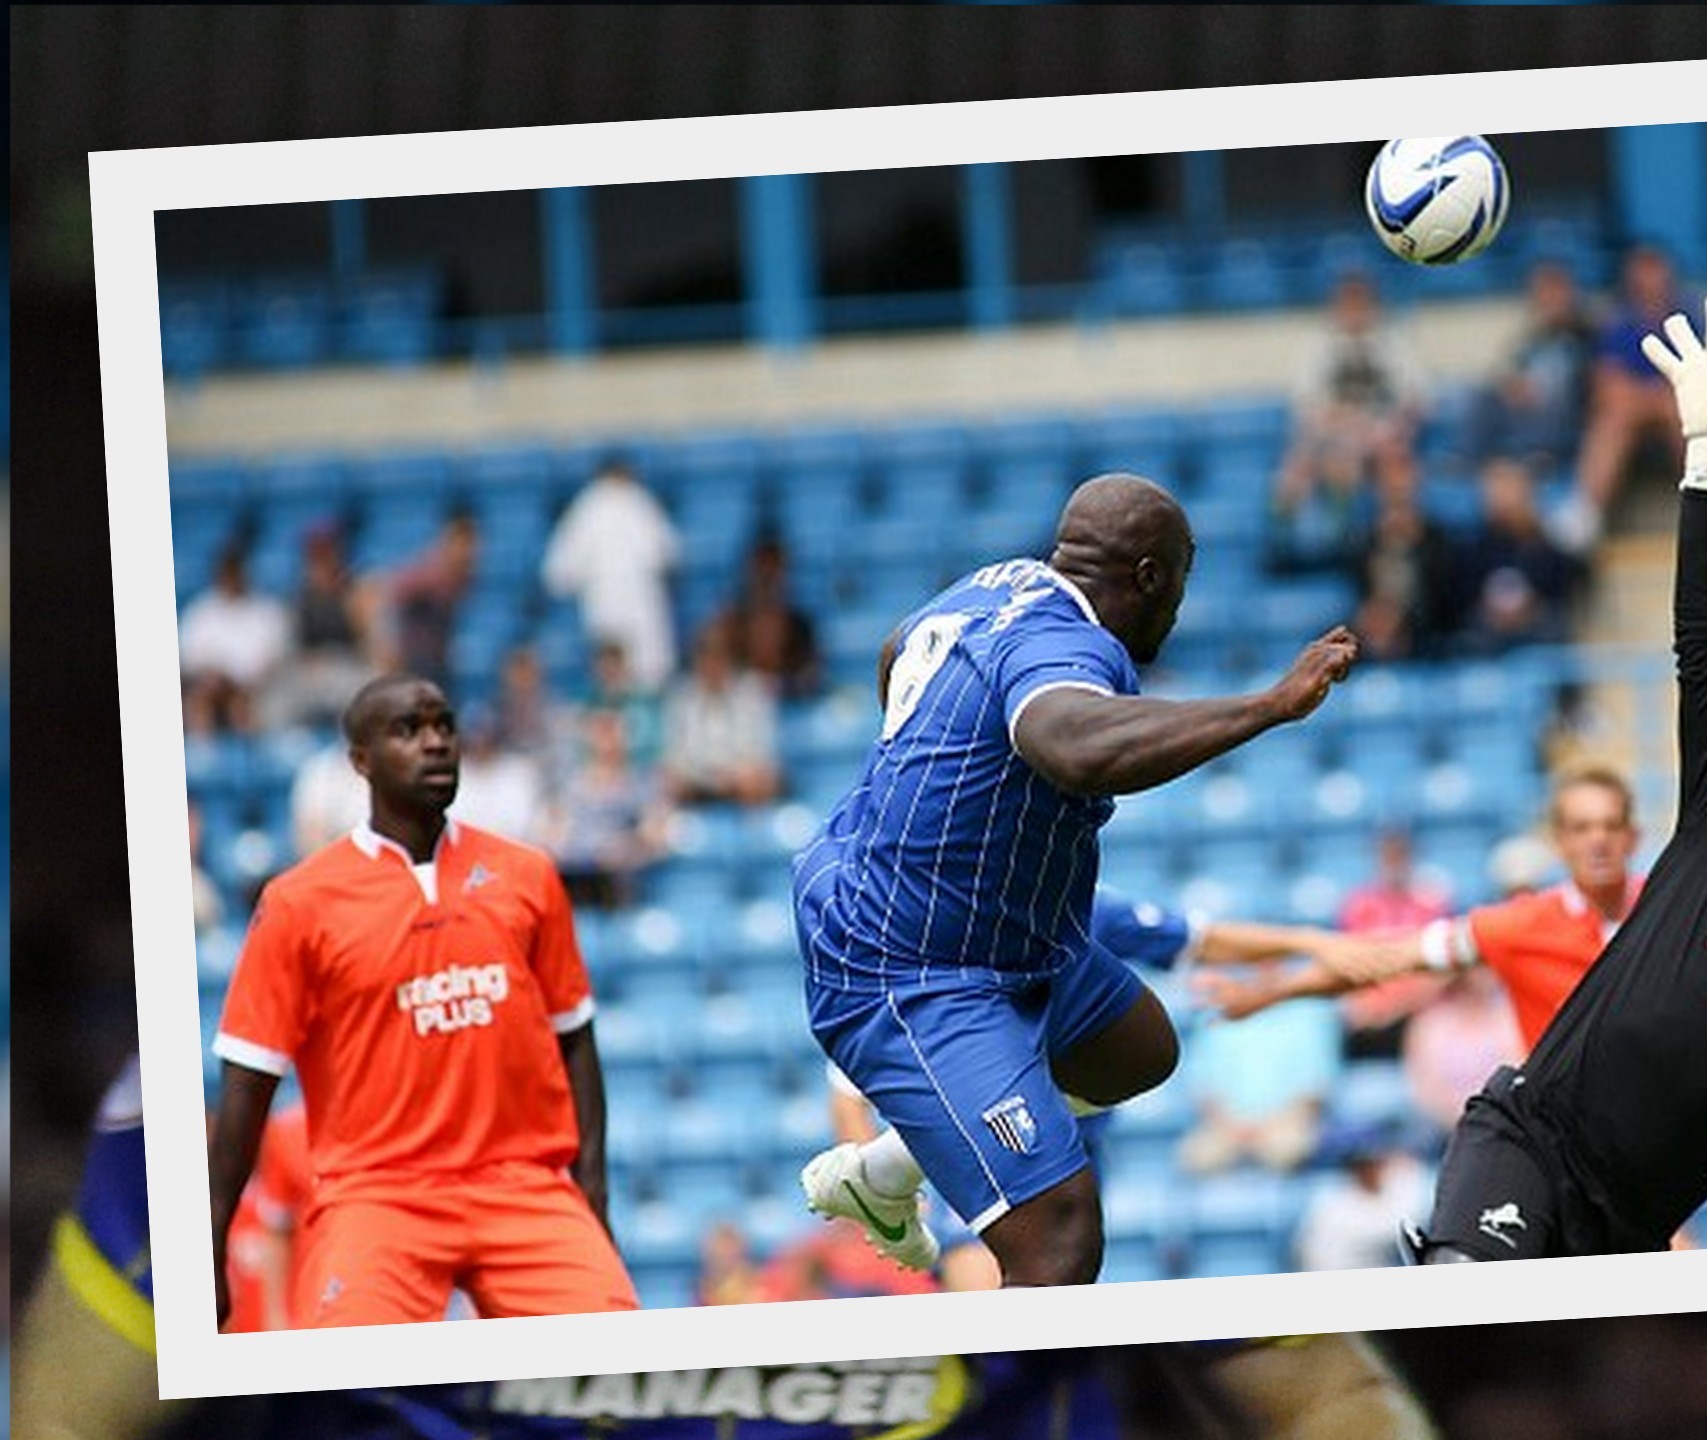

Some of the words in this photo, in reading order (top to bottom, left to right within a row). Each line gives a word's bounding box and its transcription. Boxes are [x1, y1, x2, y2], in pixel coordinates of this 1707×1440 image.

[396, 963, 509, 1012] racing
[414, 998, 493, 1038] PLUS
[493, 1367, 938, 1425] MANAGER
